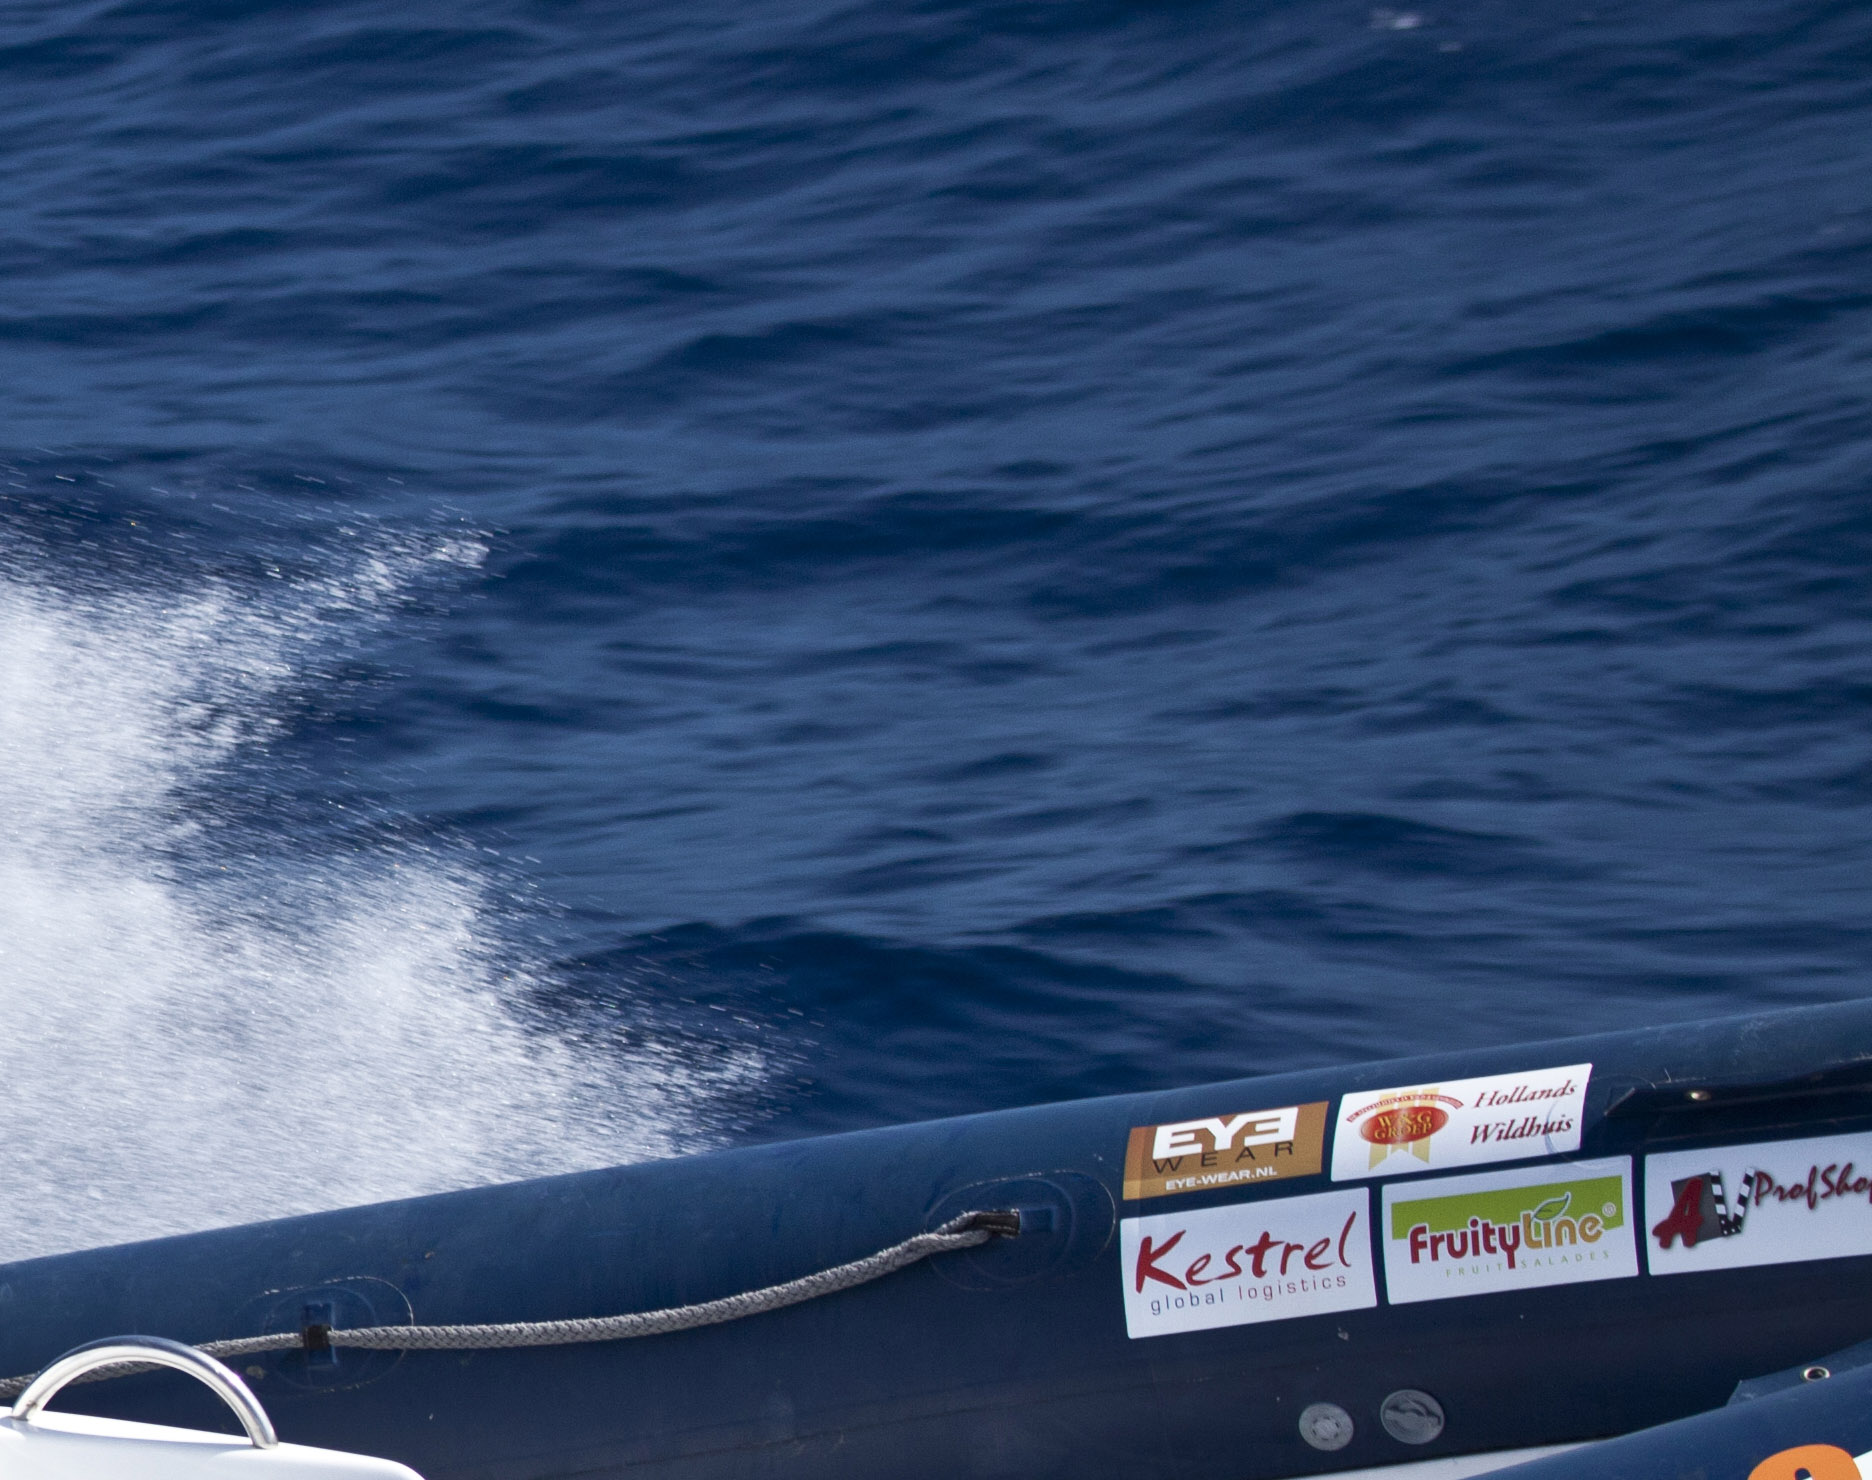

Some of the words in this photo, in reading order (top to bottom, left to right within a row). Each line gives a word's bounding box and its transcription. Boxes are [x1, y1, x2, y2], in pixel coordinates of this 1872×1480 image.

[1473, 1080, 1578, 1108] Hollands
[1153, 1106, 1299, 1160] EYE
[1470, 1114, 1574, 1145] Wildhuis
[1153, 1140, 1295, 1175] WEAR
[1164, 1165, 1278, 1191] EYE-WEAR.NL
[1134, 1210, 1356, 1293] Kestrel
[1409, 1204, 1605, 1270] FruityLine
[1445, 1258, 1506, 1279] FRUIT
[1520, 1248, 1612, 1271] SALADES
[1150, 1284, 1226, 1315] global
[1237, 1272, 1348, 1301] logistics
